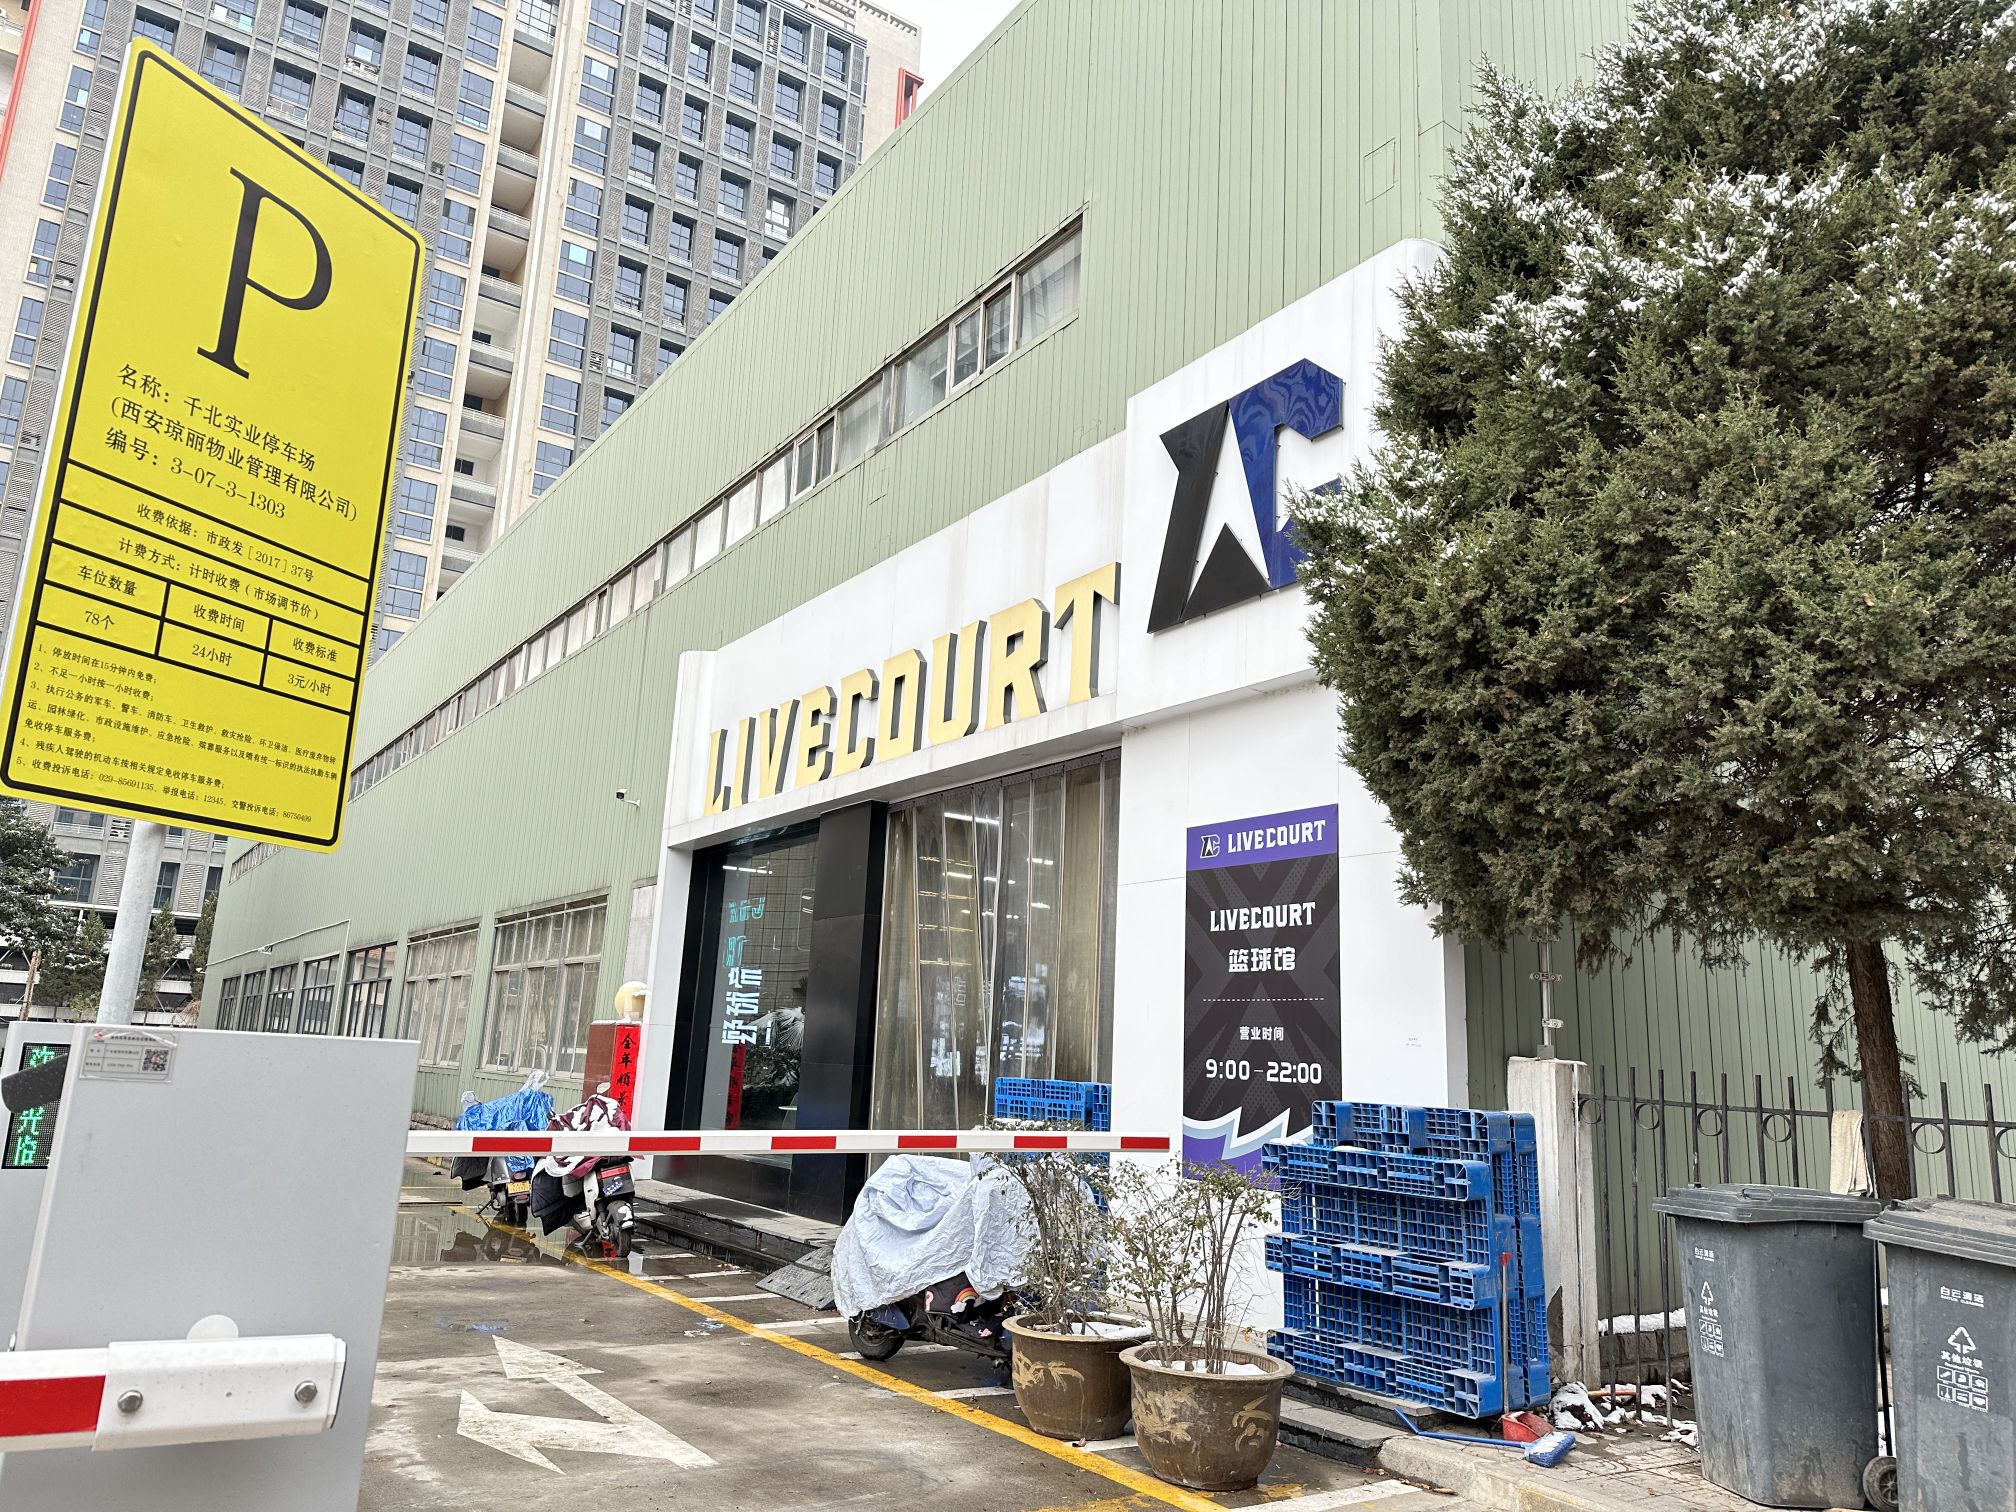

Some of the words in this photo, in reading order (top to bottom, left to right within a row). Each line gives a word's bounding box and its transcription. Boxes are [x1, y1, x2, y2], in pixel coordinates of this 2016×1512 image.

[196, 166, 333, 380] P
[117, 363, 316, 472] 名称：千北实业停车场
[78, 564, 138, 597] 车位数量
[84, 610, 115, 631] 78个
[193, 603, 245, 633] 收费时间
[192, 644, 232, 666] 24小时
[292, 637, 337, 663] 收费标准
[287, 673, 332, 695] 3元/小时
[703, 561, 1122, 817] LIVECOURT
[1227, 819, 1326, 854] LIVECOURT
[1210, 901, 1316, 933] LIVECOURT
[1228, 946, 1296, 973] 篮球馆
[1239, 1026, 1284, 1041] 营业时间
